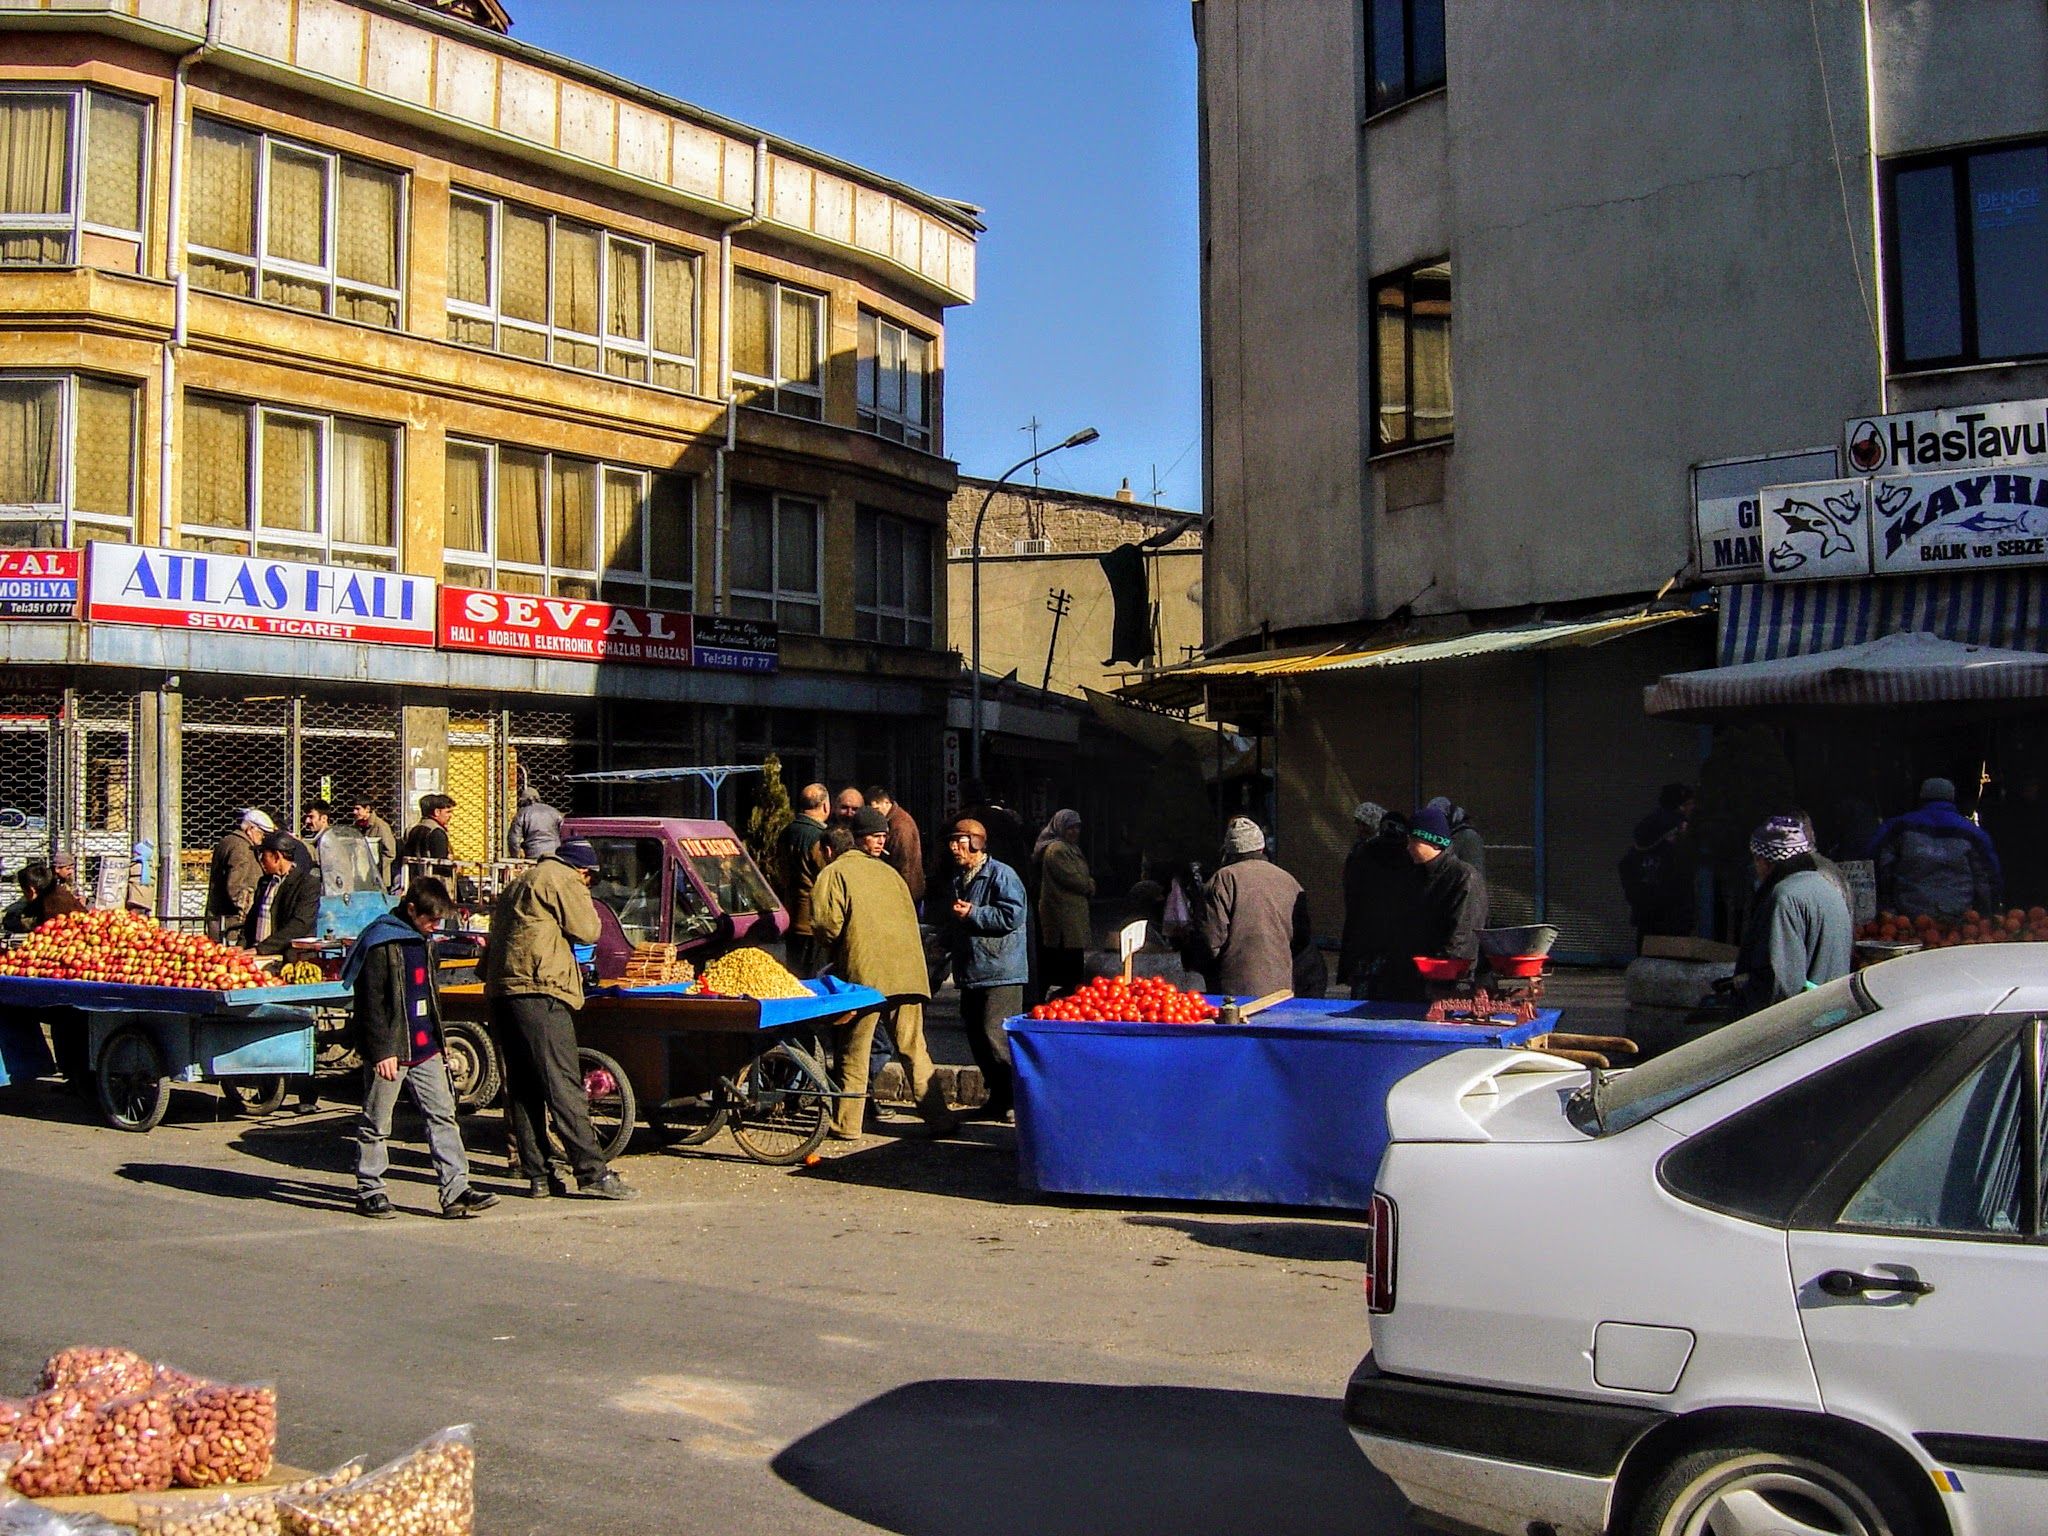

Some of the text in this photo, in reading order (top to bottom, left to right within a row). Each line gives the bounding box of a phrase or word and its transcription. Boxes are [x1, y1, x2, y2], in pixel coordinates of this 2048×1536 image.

[1889, 407, 2048, 466] HasTavu
[1921, 543, 1967, 561] BALIK
[1973, 545, 1993, 559] ve
[1997, 538, 2045, 557] SEBZE
[121, 550, 415, 621] ATLAS HALI
[11, 603, 72, 614] Tel:351 07 77
[464, 593, 676, 640] SEV-AL
[188, 612, 261, 631] SEVAL
[450, 626, 475, 642] HALI
[703, 652, 770, 668] Tel:351 07 77
